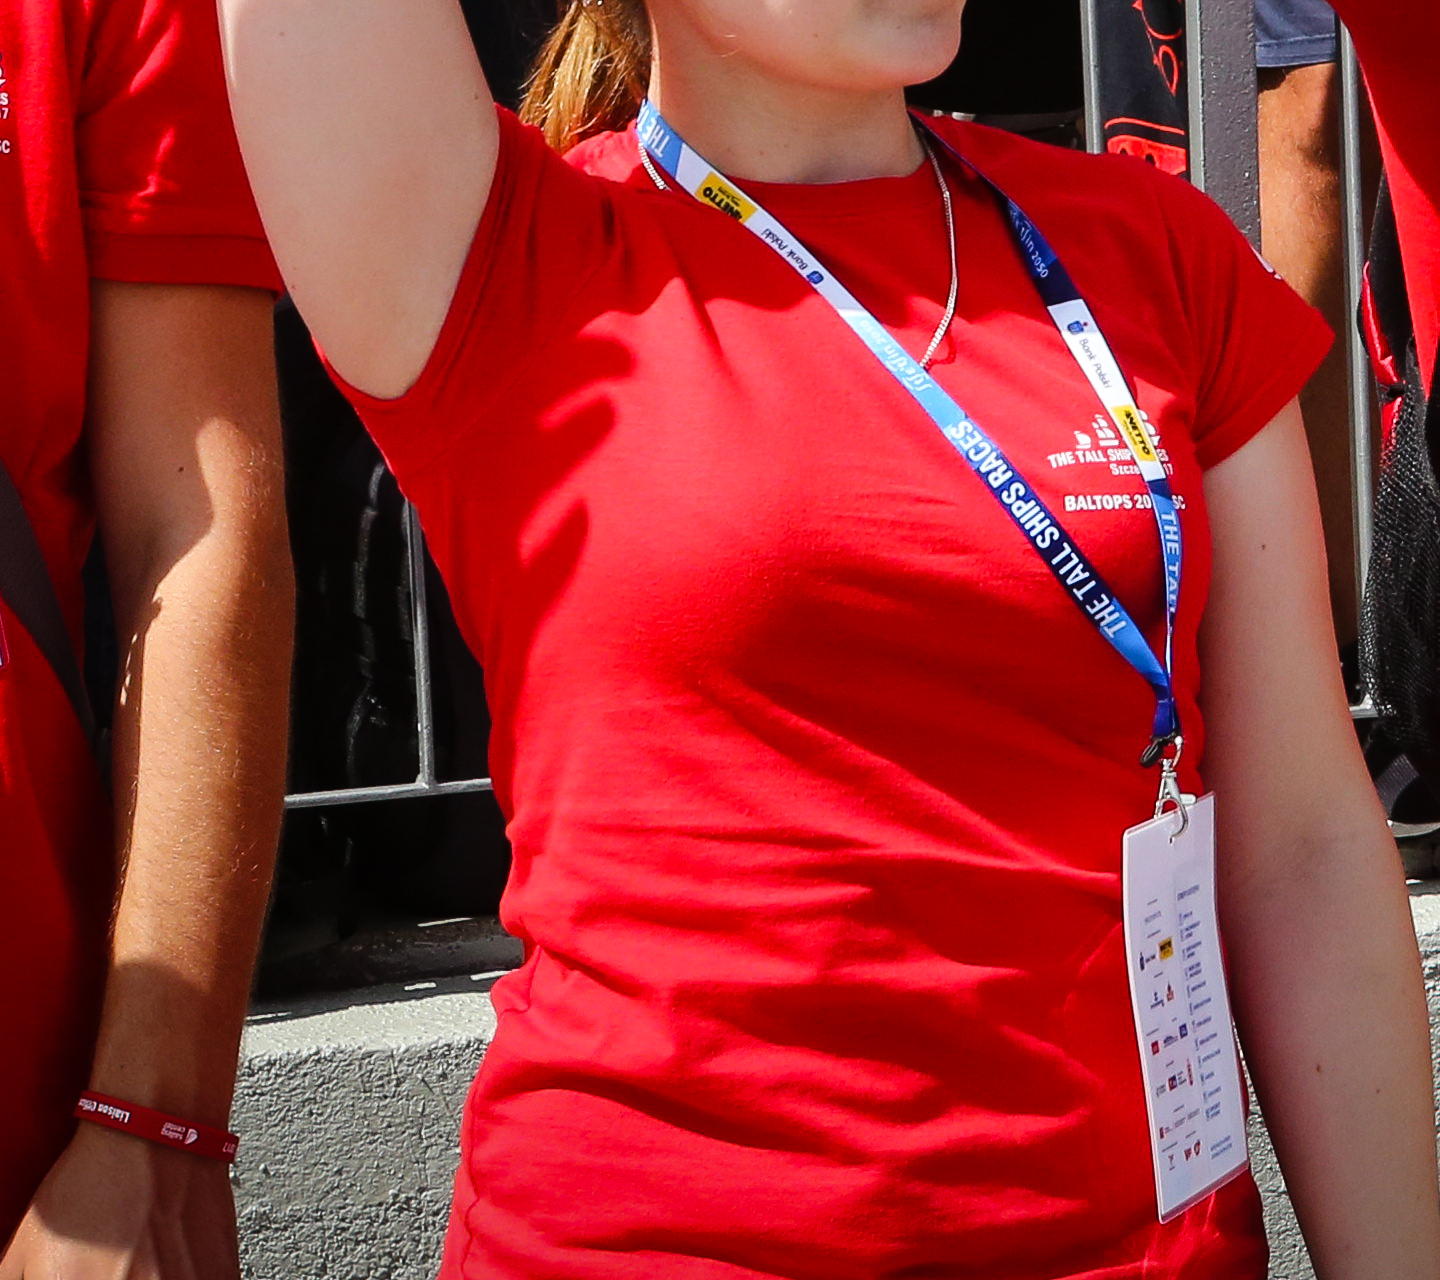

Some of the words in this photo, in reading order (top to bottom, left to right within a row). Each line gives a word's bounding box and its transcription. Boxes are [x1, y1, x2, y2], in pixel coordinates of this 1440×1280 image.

[702, 185, 741, 221] NETTO
[1030, 251, 1050, 280] 2050
[948, 419, 1012, 490] RACES
[1127, 414, 1152, 457] NETTO
[1047, 452, 1076, 469] THE
[1076, 449, 1108, 464] TALL
[1000, 479, 1061, 550] SHIPS
[1064, 494, 1133, 512] BALTOPS
[1133, 495, 1152, 510] 20
[1160, 509, 1181, 562] THE
[1051, 541, 1098, 602] TALL
[1086, 593, 1129, 640] THE
[97, 1103, 131, 1124] Liaison
